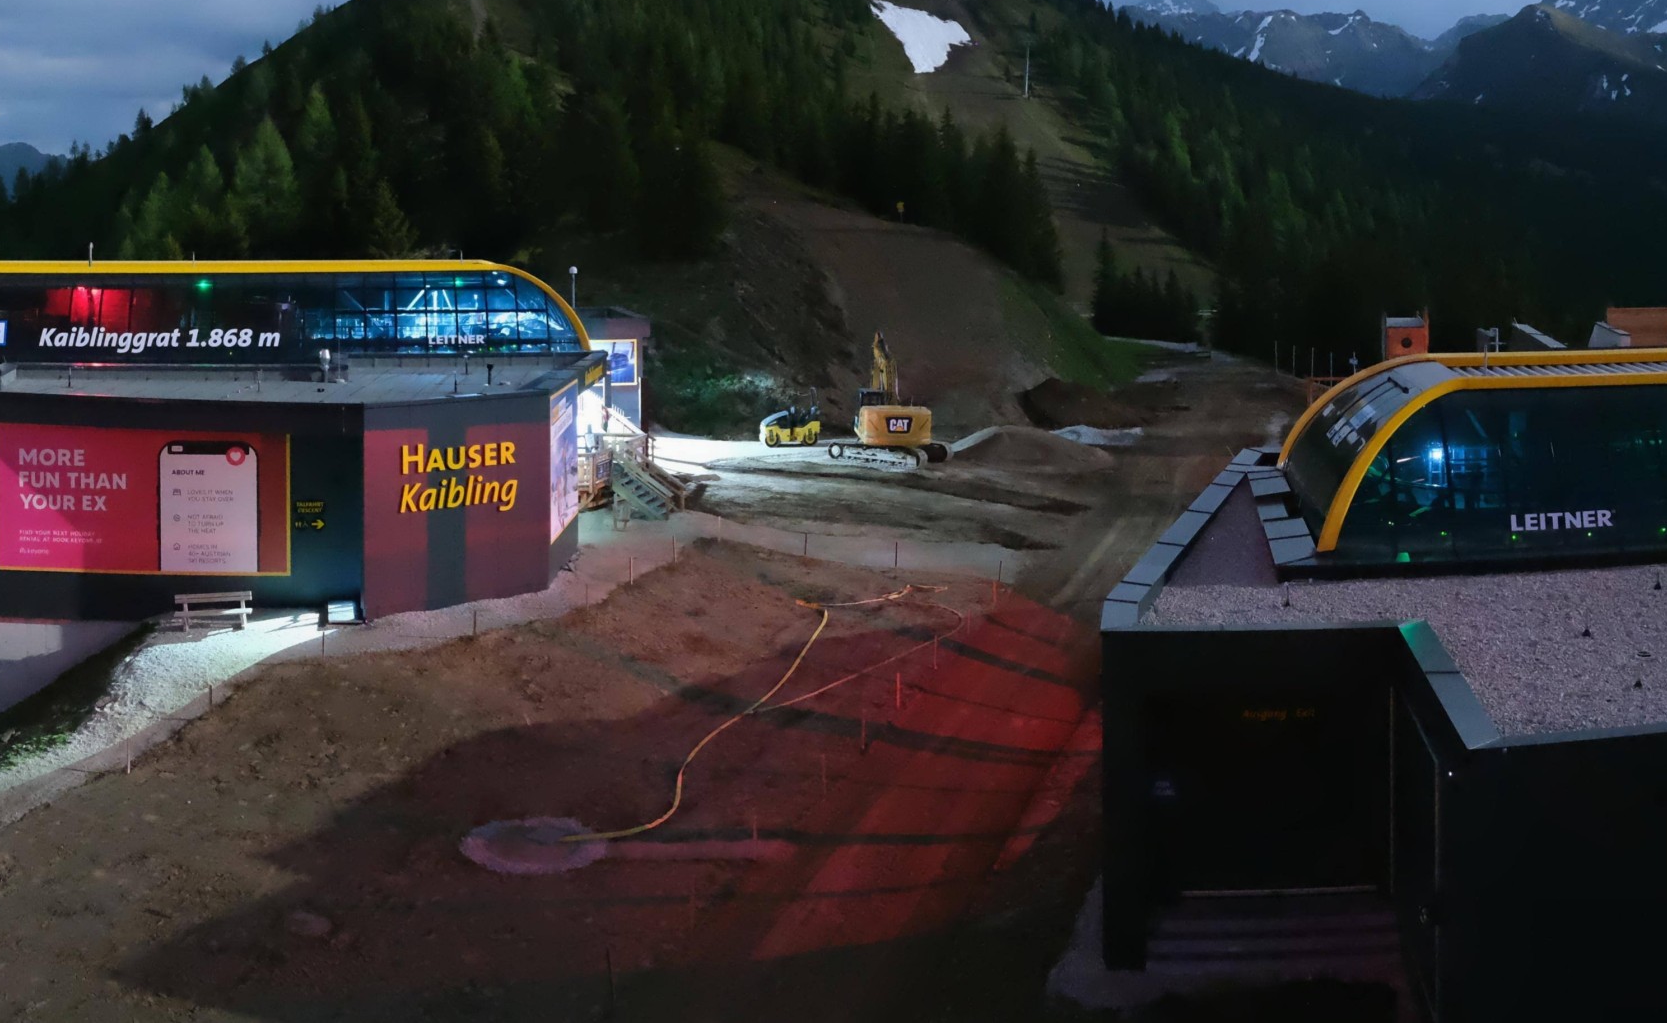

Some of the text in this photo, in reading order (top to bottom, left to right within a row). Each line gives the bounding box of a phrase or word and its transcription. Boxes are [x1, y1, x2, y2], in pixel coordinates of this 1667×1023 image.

[38, 327, 280, 354] Kaiblinggrat 1.868 m
[428, 334, 485, 346] LEITNER
[889, 418, 910, 432] CAT
[18, 448, 85, 466] MORE
[401, 441, 516, 475] HAUSER
[19, 471, 127, 490] FUN THAN
[20, 493, 107, 511] YOUR EX
[400, 475, 518, 513] Kaibling
[1510, 509, 1613, 532] LEITNER
